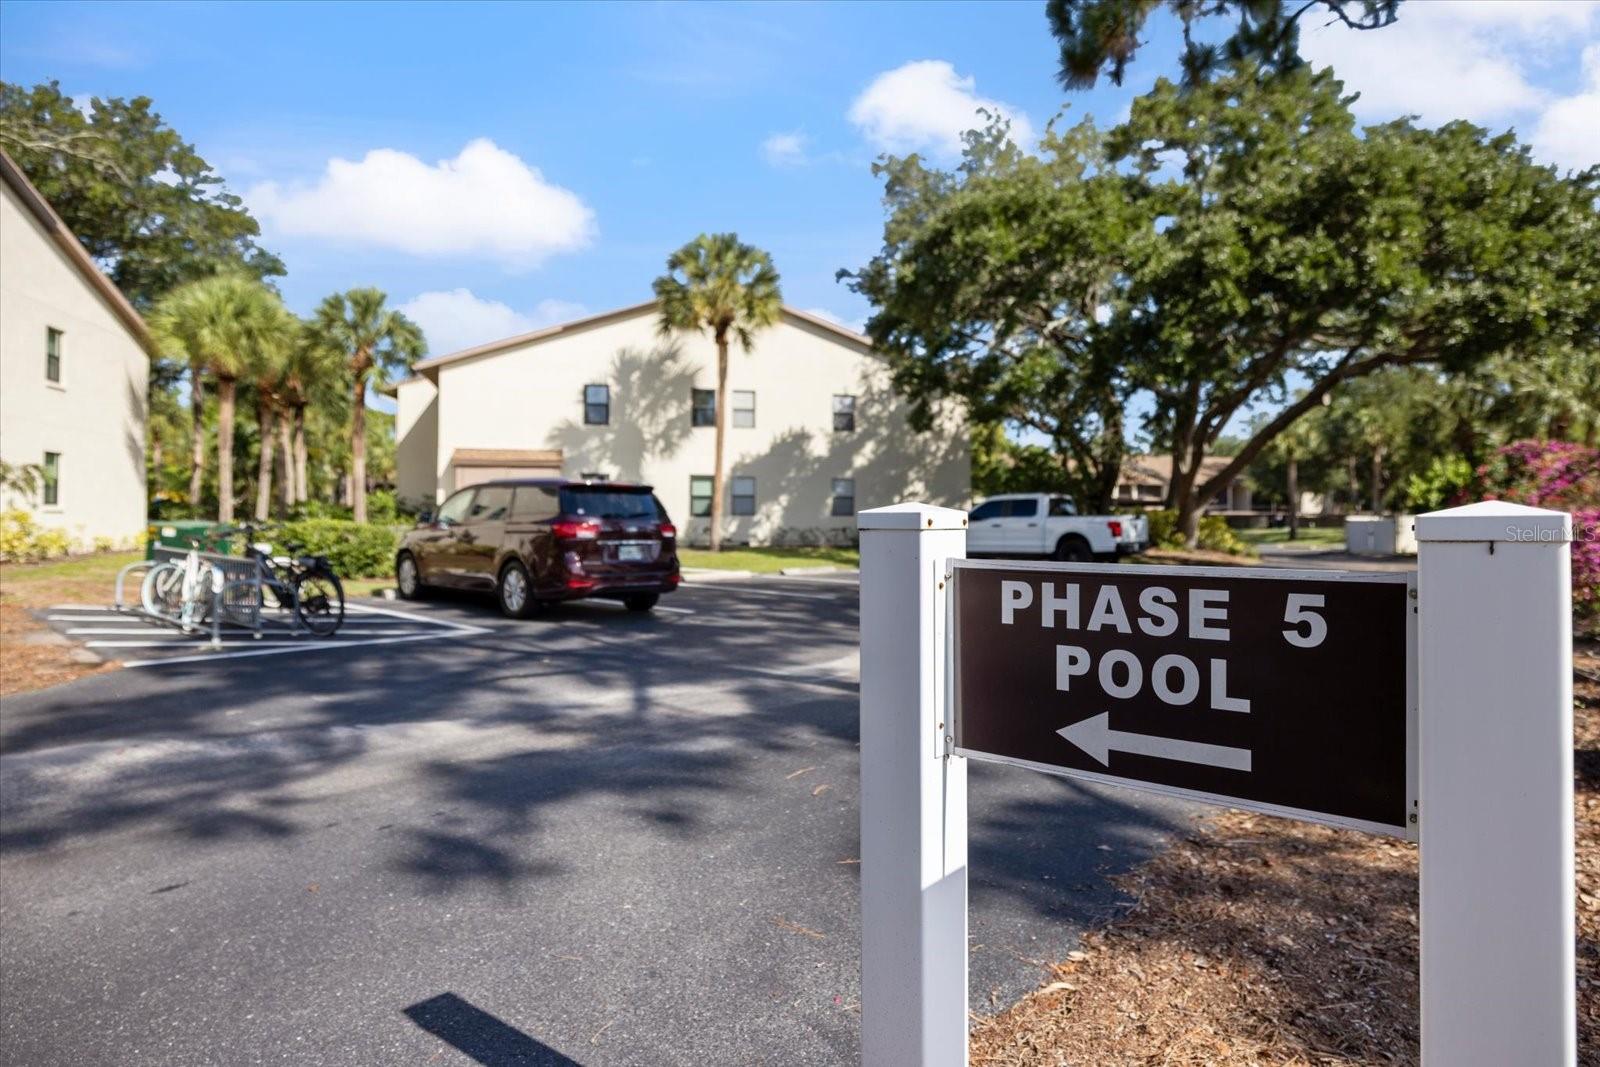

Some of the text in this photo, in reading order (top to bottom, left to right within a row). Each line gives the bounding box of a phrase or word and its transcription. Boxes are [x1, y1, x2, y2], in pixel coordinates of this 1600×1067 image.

[1000, 580, 1329, 648] PHASE 5
[1055, 644, 1252, 713] POOL
